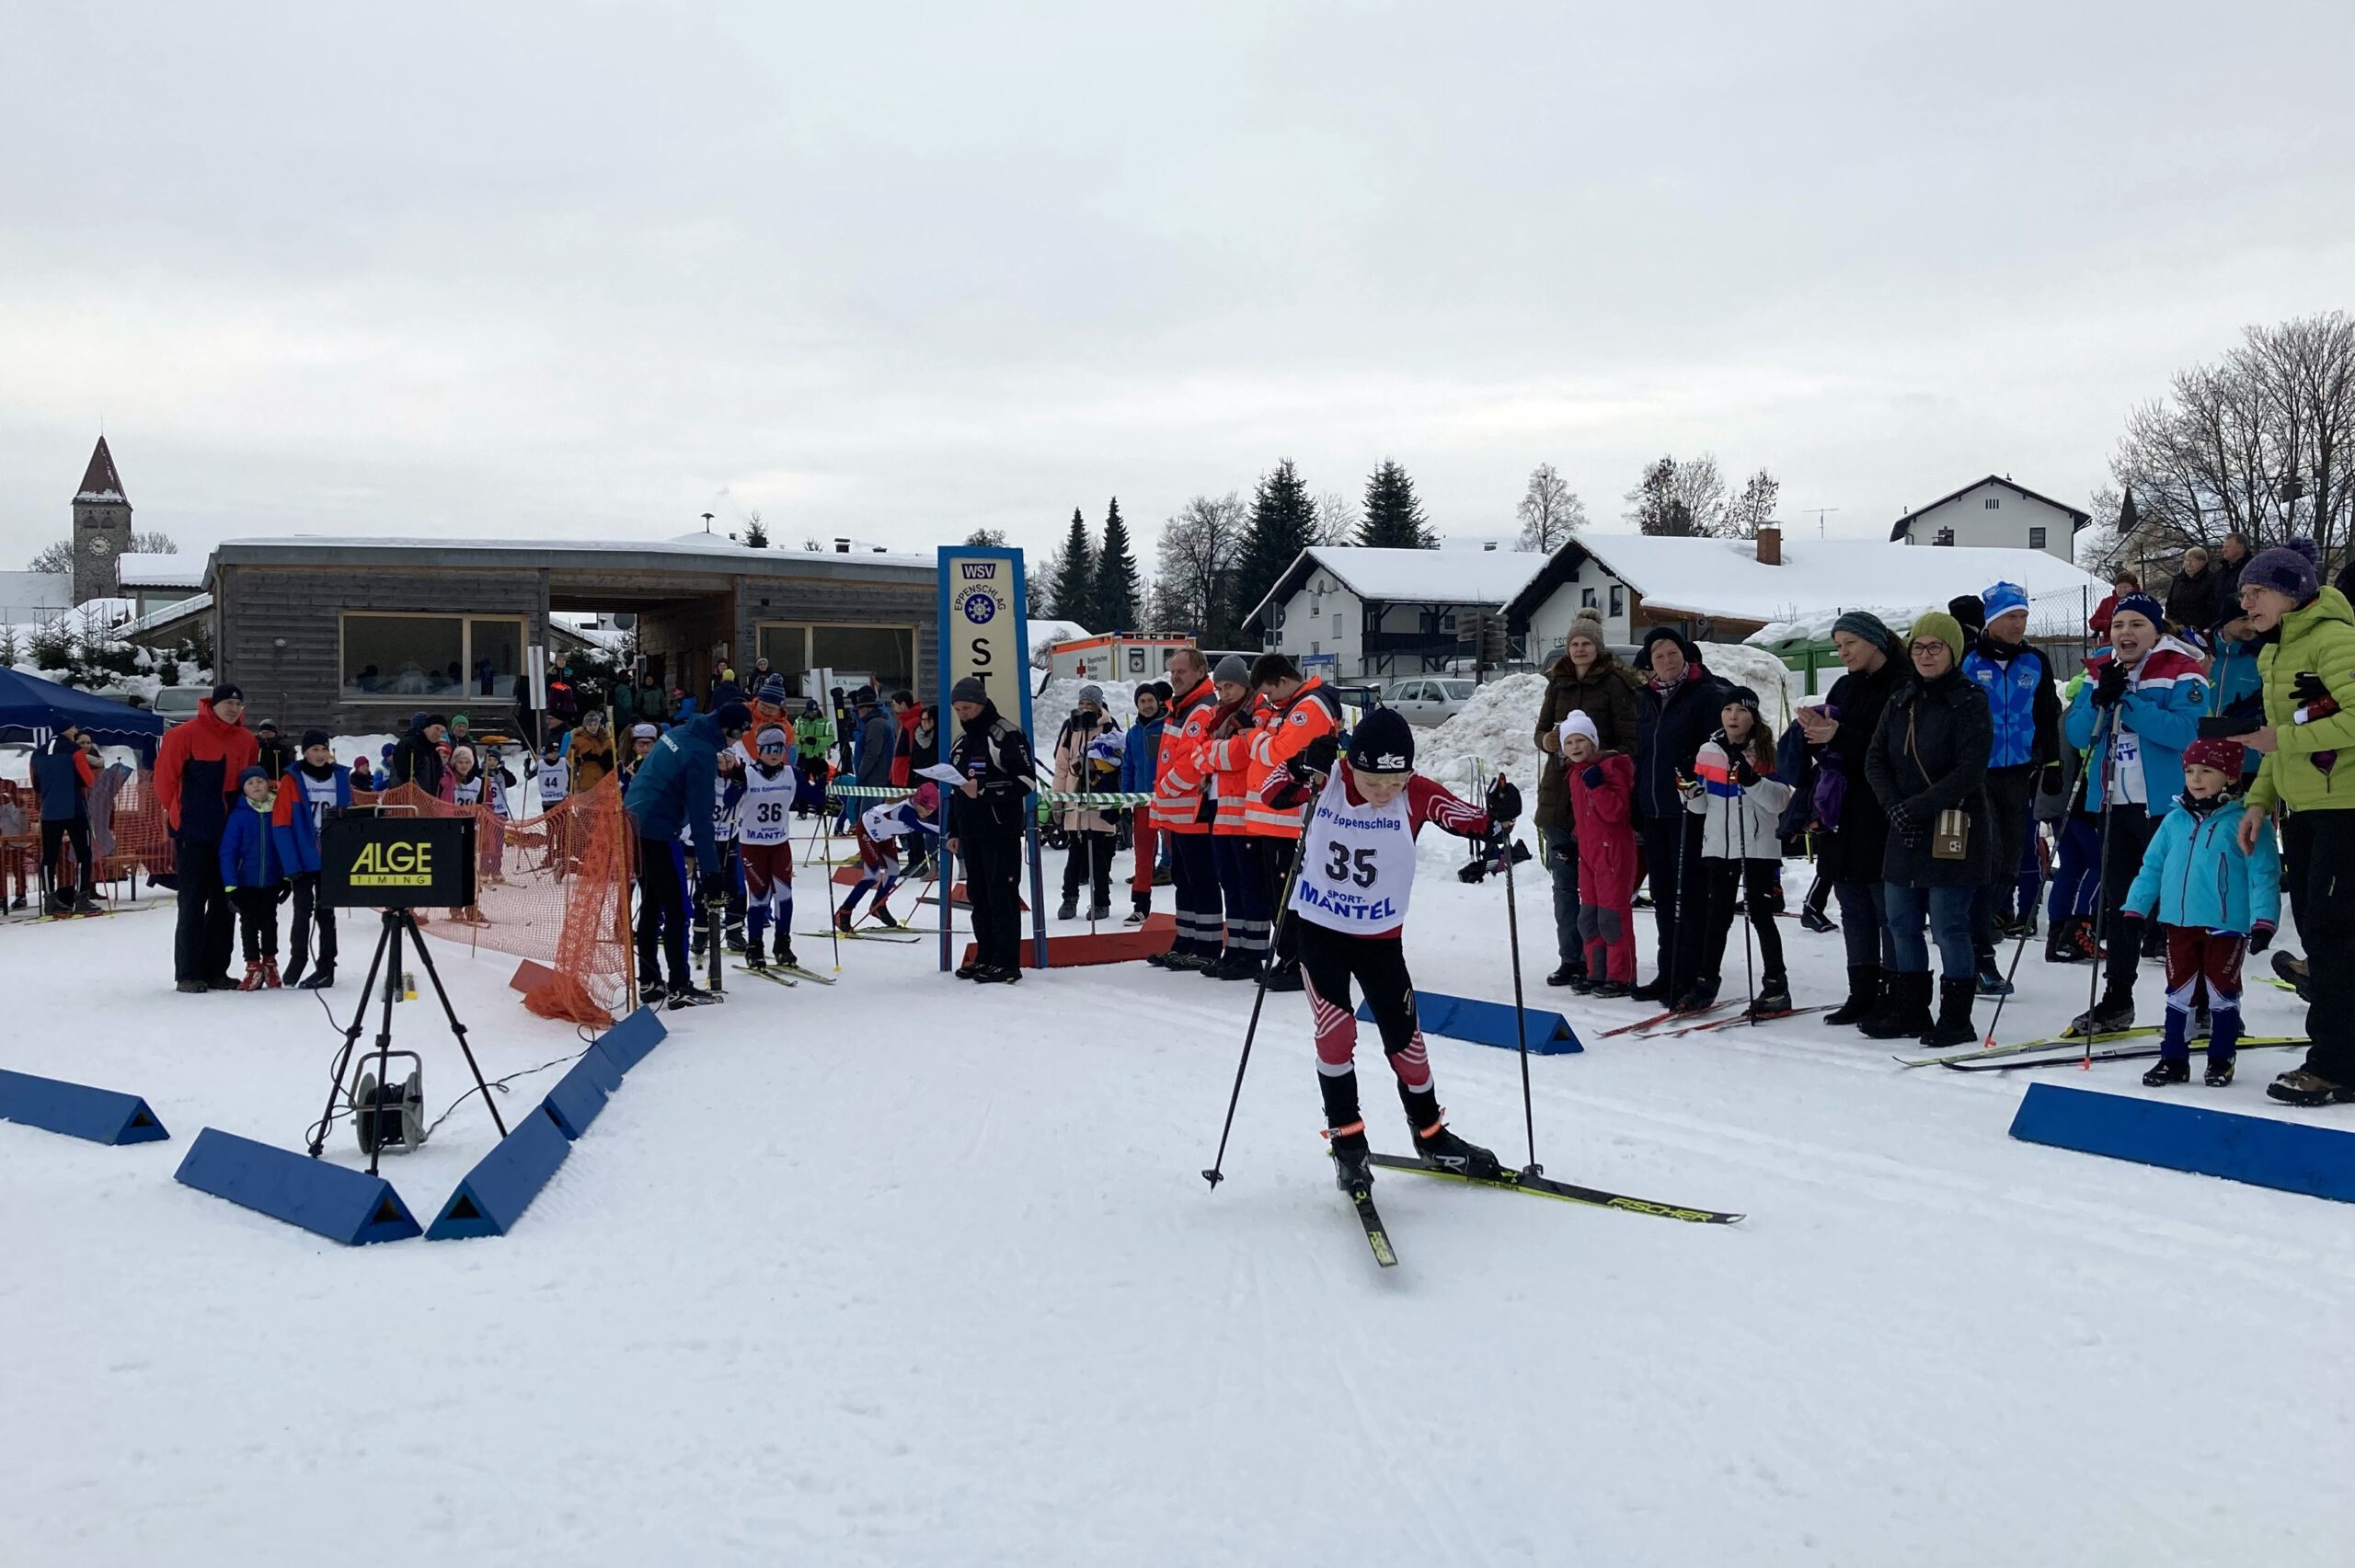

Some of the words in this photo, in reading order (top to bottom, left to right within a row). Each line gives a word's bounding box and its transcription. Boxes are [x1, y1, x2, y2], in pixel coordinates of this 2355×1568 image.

[964, 565, 994, 578] WSV
[954, 583, 1006, 611] EPPENSCHLAG
[545, 776, 558, 788] 44
[757, 802, 782, 823] 36
[350, 841, 432, 873] ALGE
[1326, 841, 1378, 889] 35
[356, 876, 426, 885] TIMING
[1299, 880, 1396, 920] MANTEL
[1327, 889, 1367, 903] SPORT-
[1607, 1197, 1715, 1222] FISCHER
